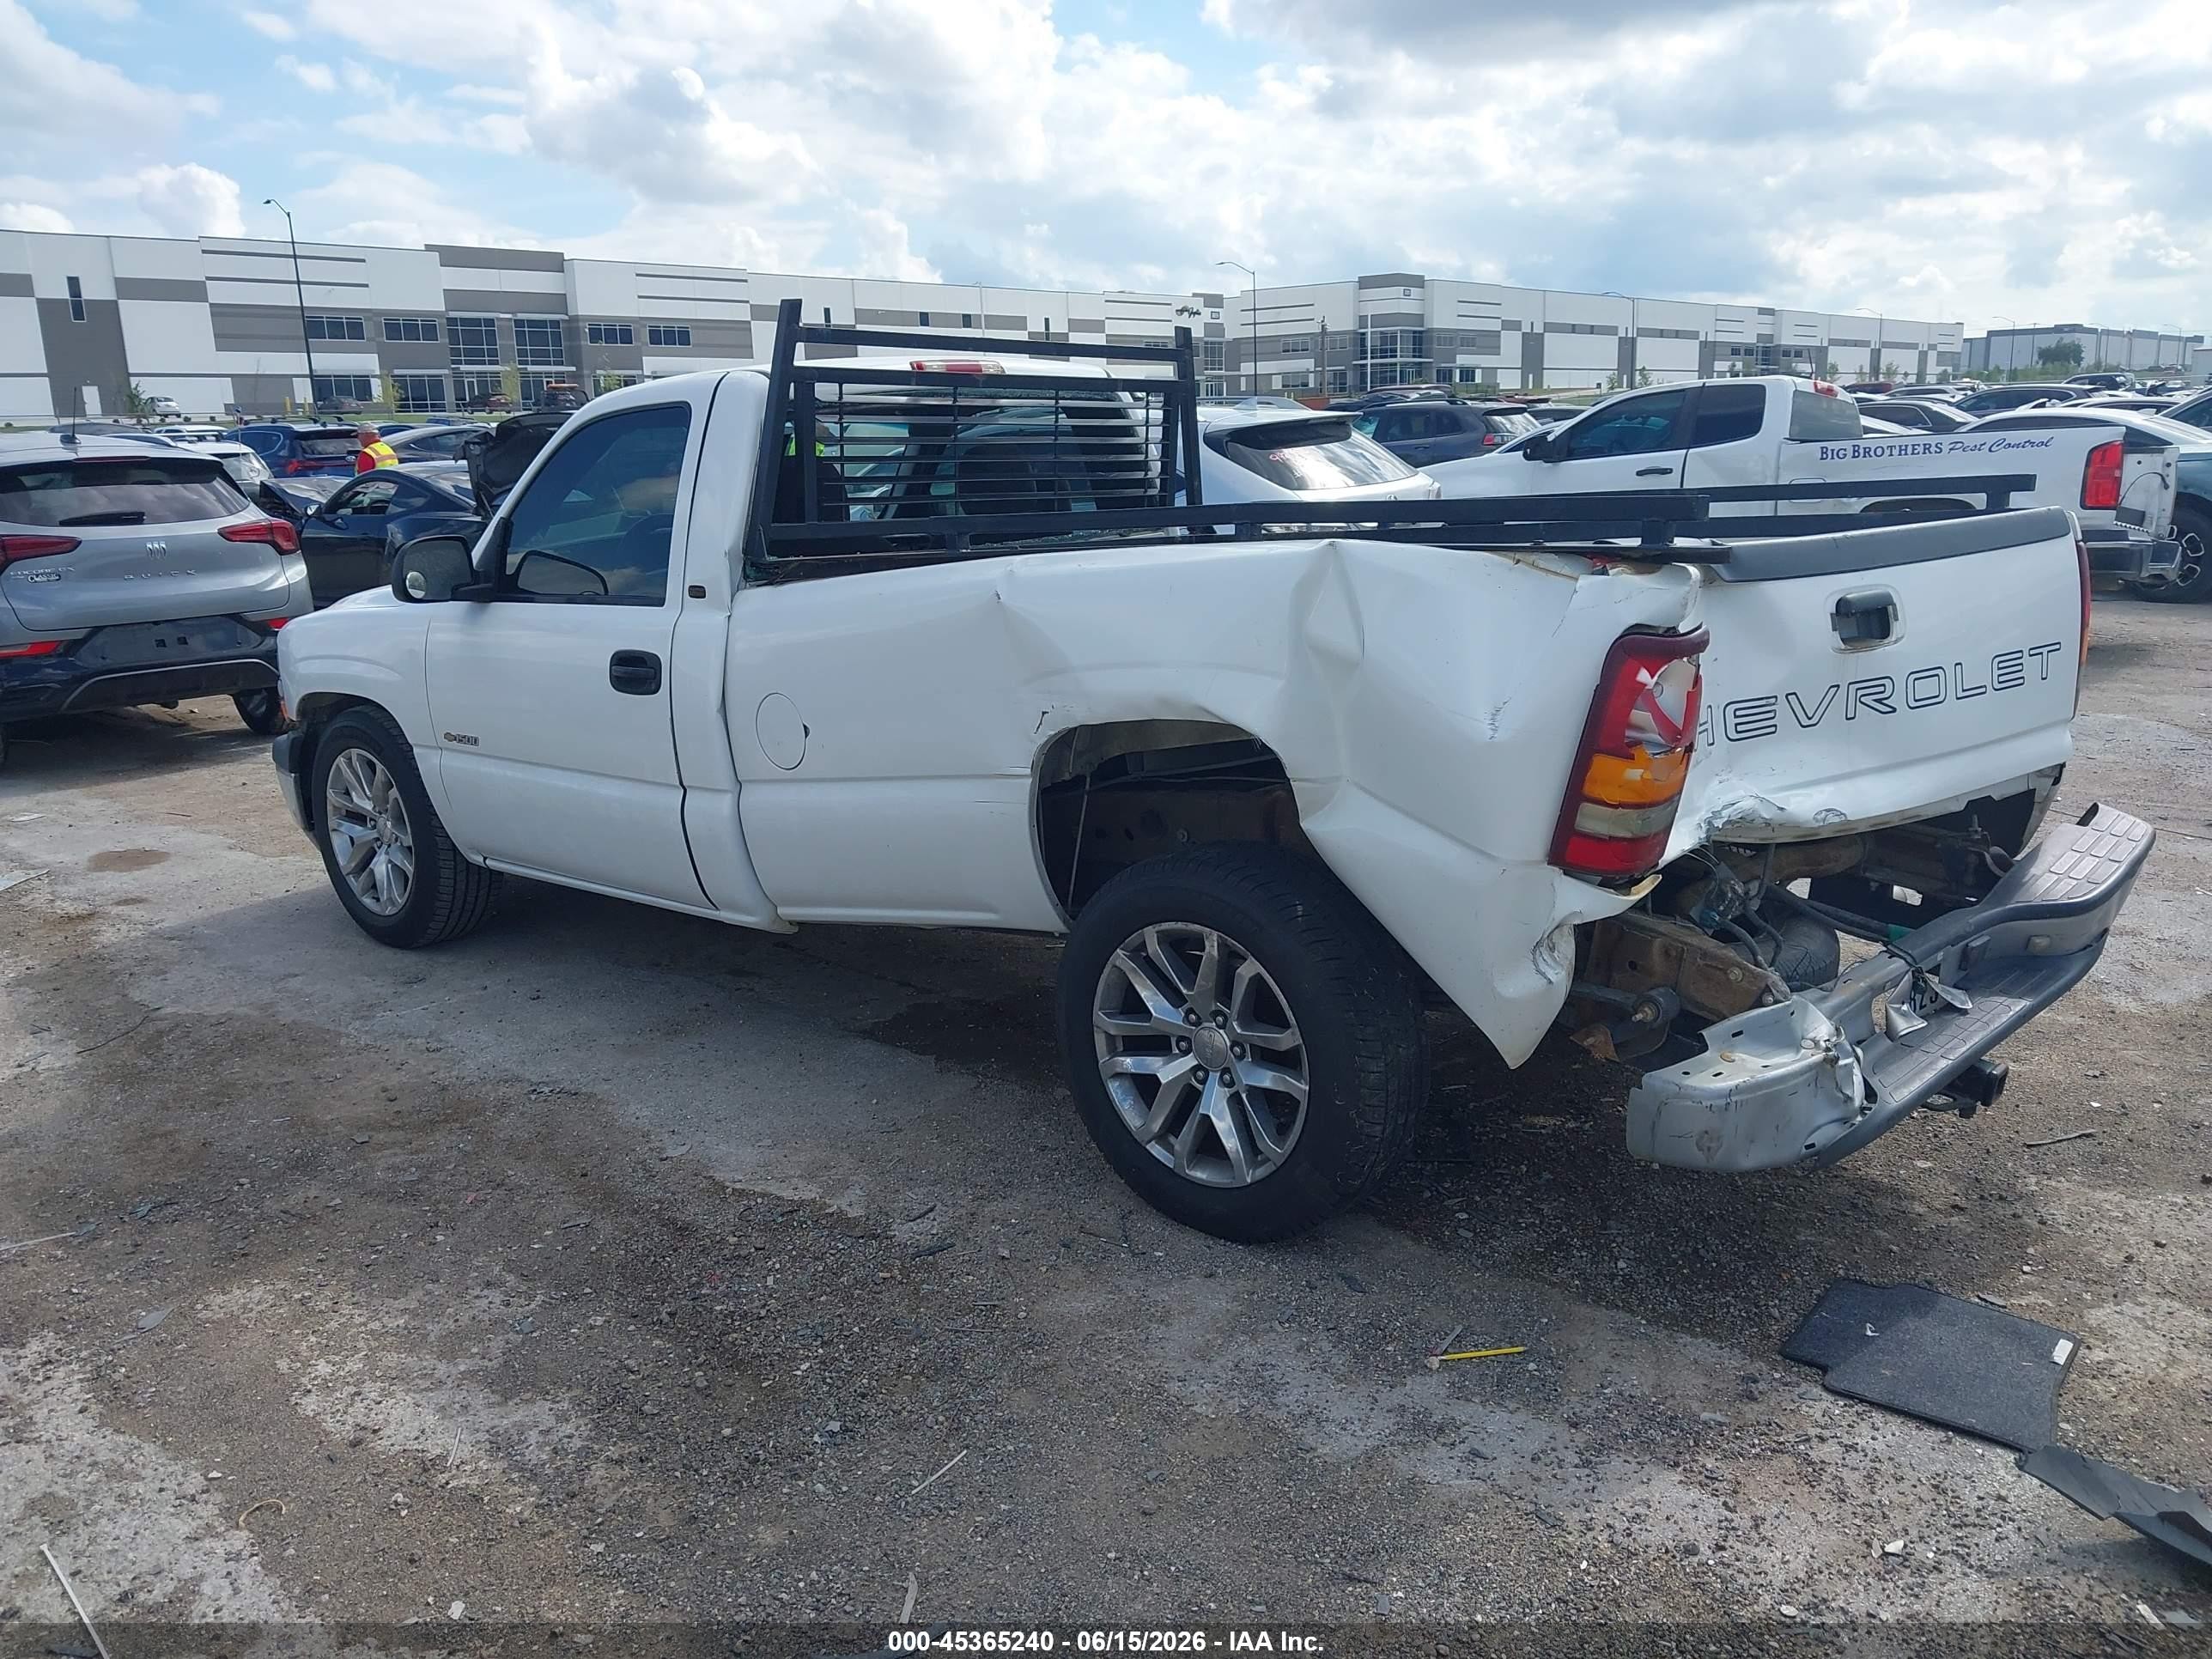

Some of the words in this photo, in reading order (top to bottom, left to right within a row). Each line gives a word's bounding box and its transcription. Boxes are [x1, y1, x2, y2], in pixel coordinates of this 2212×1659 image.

[1820, 446, 1847, 460] BIG
[1851, 441, 1943, 459] BROTHERS
[1948, 439, 1985, 454] Pest
[1988, 436, 2054, 453] Control
[1693, 641, 2062, 751] HEVROLET
[455, 733, 480, 747] 1500
